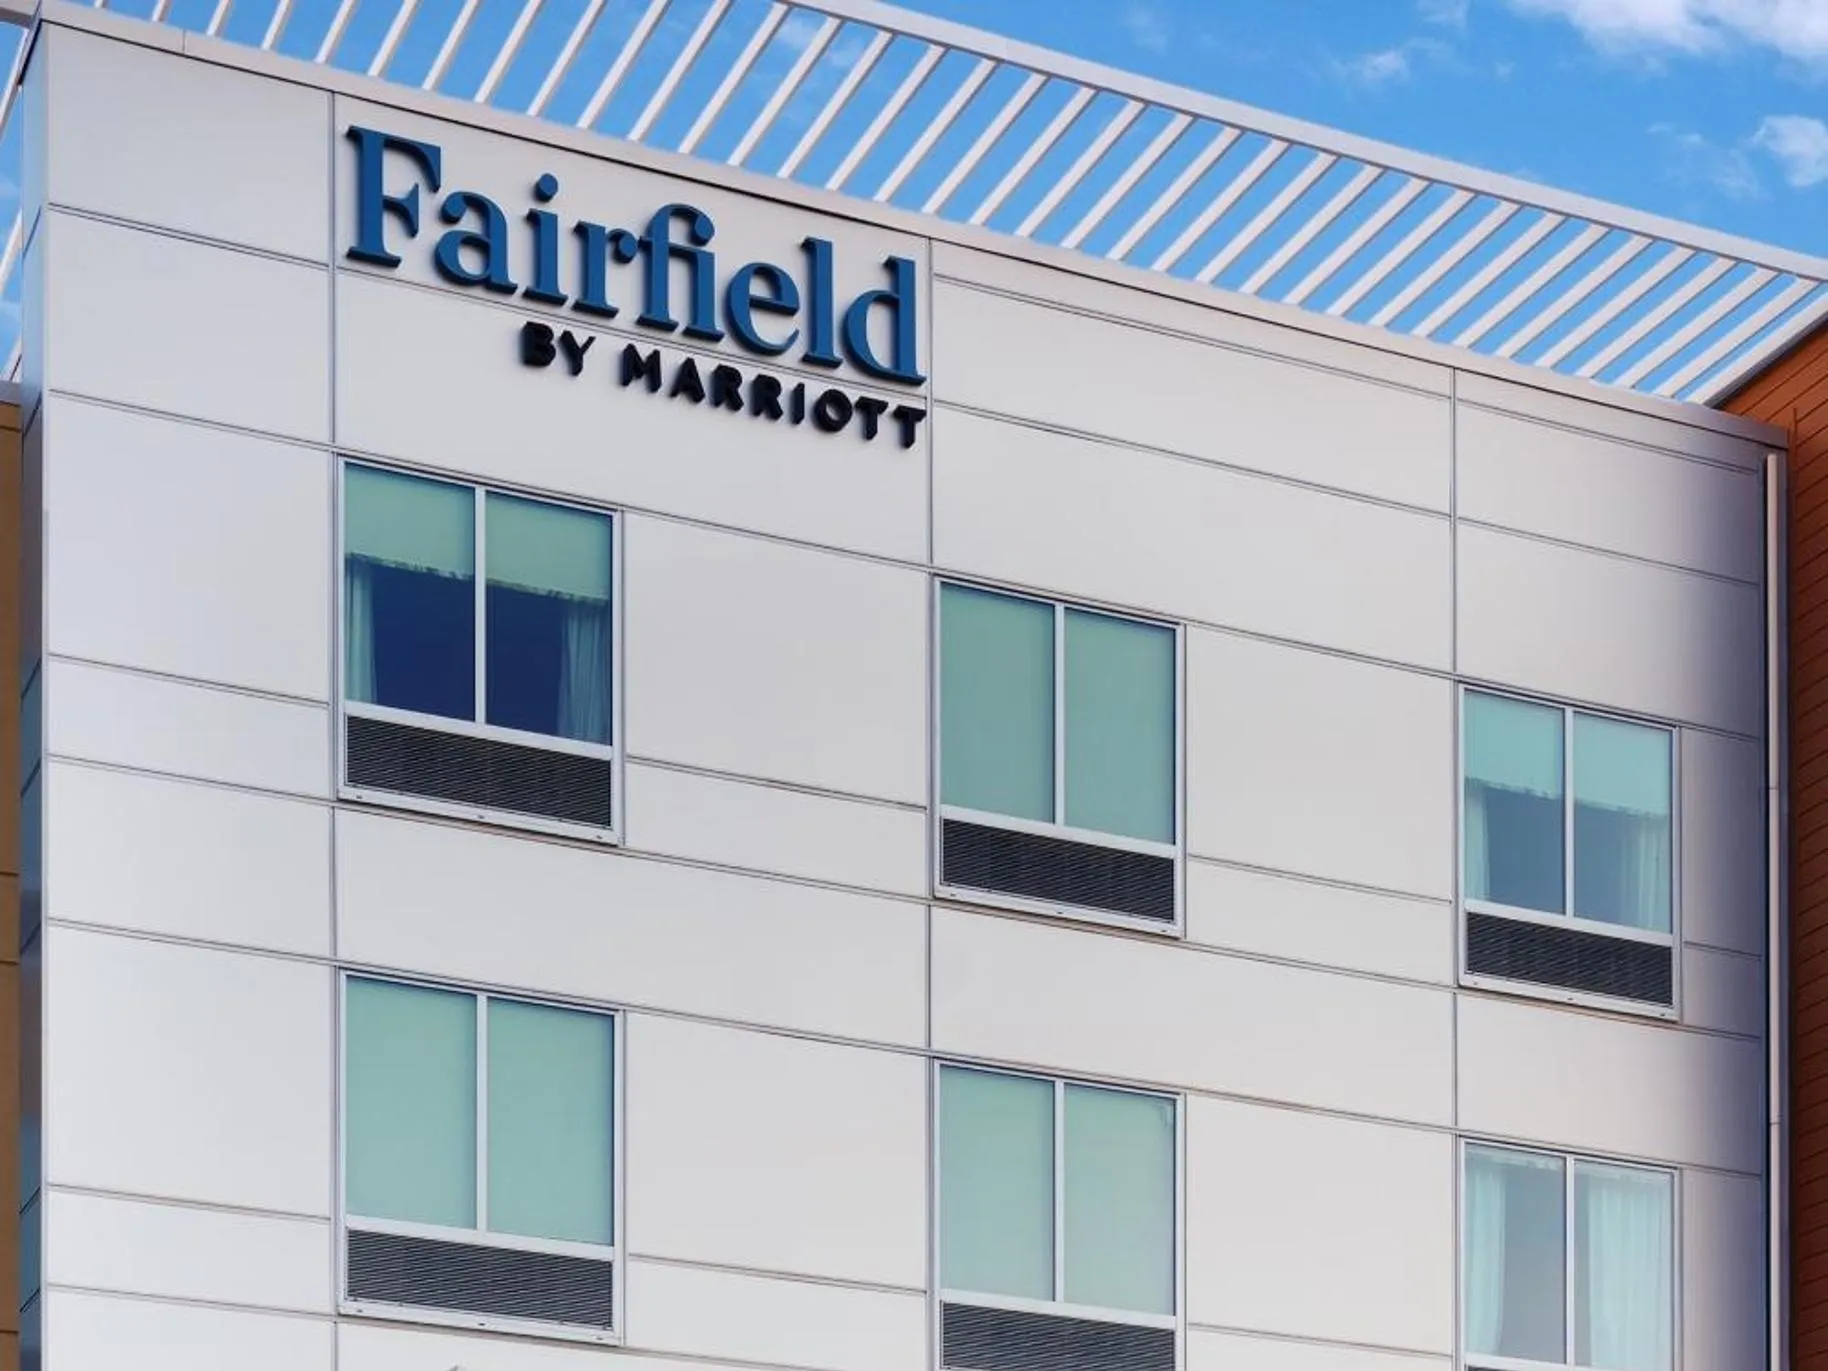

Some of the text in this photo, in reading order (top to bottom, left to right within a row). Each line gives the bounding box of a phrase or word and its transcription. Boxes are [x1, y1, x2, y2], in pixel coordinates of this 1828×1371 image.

[345, 125, 927, 387] Fairfield
[521, 321, 927, 449] BY MARRIOTT
